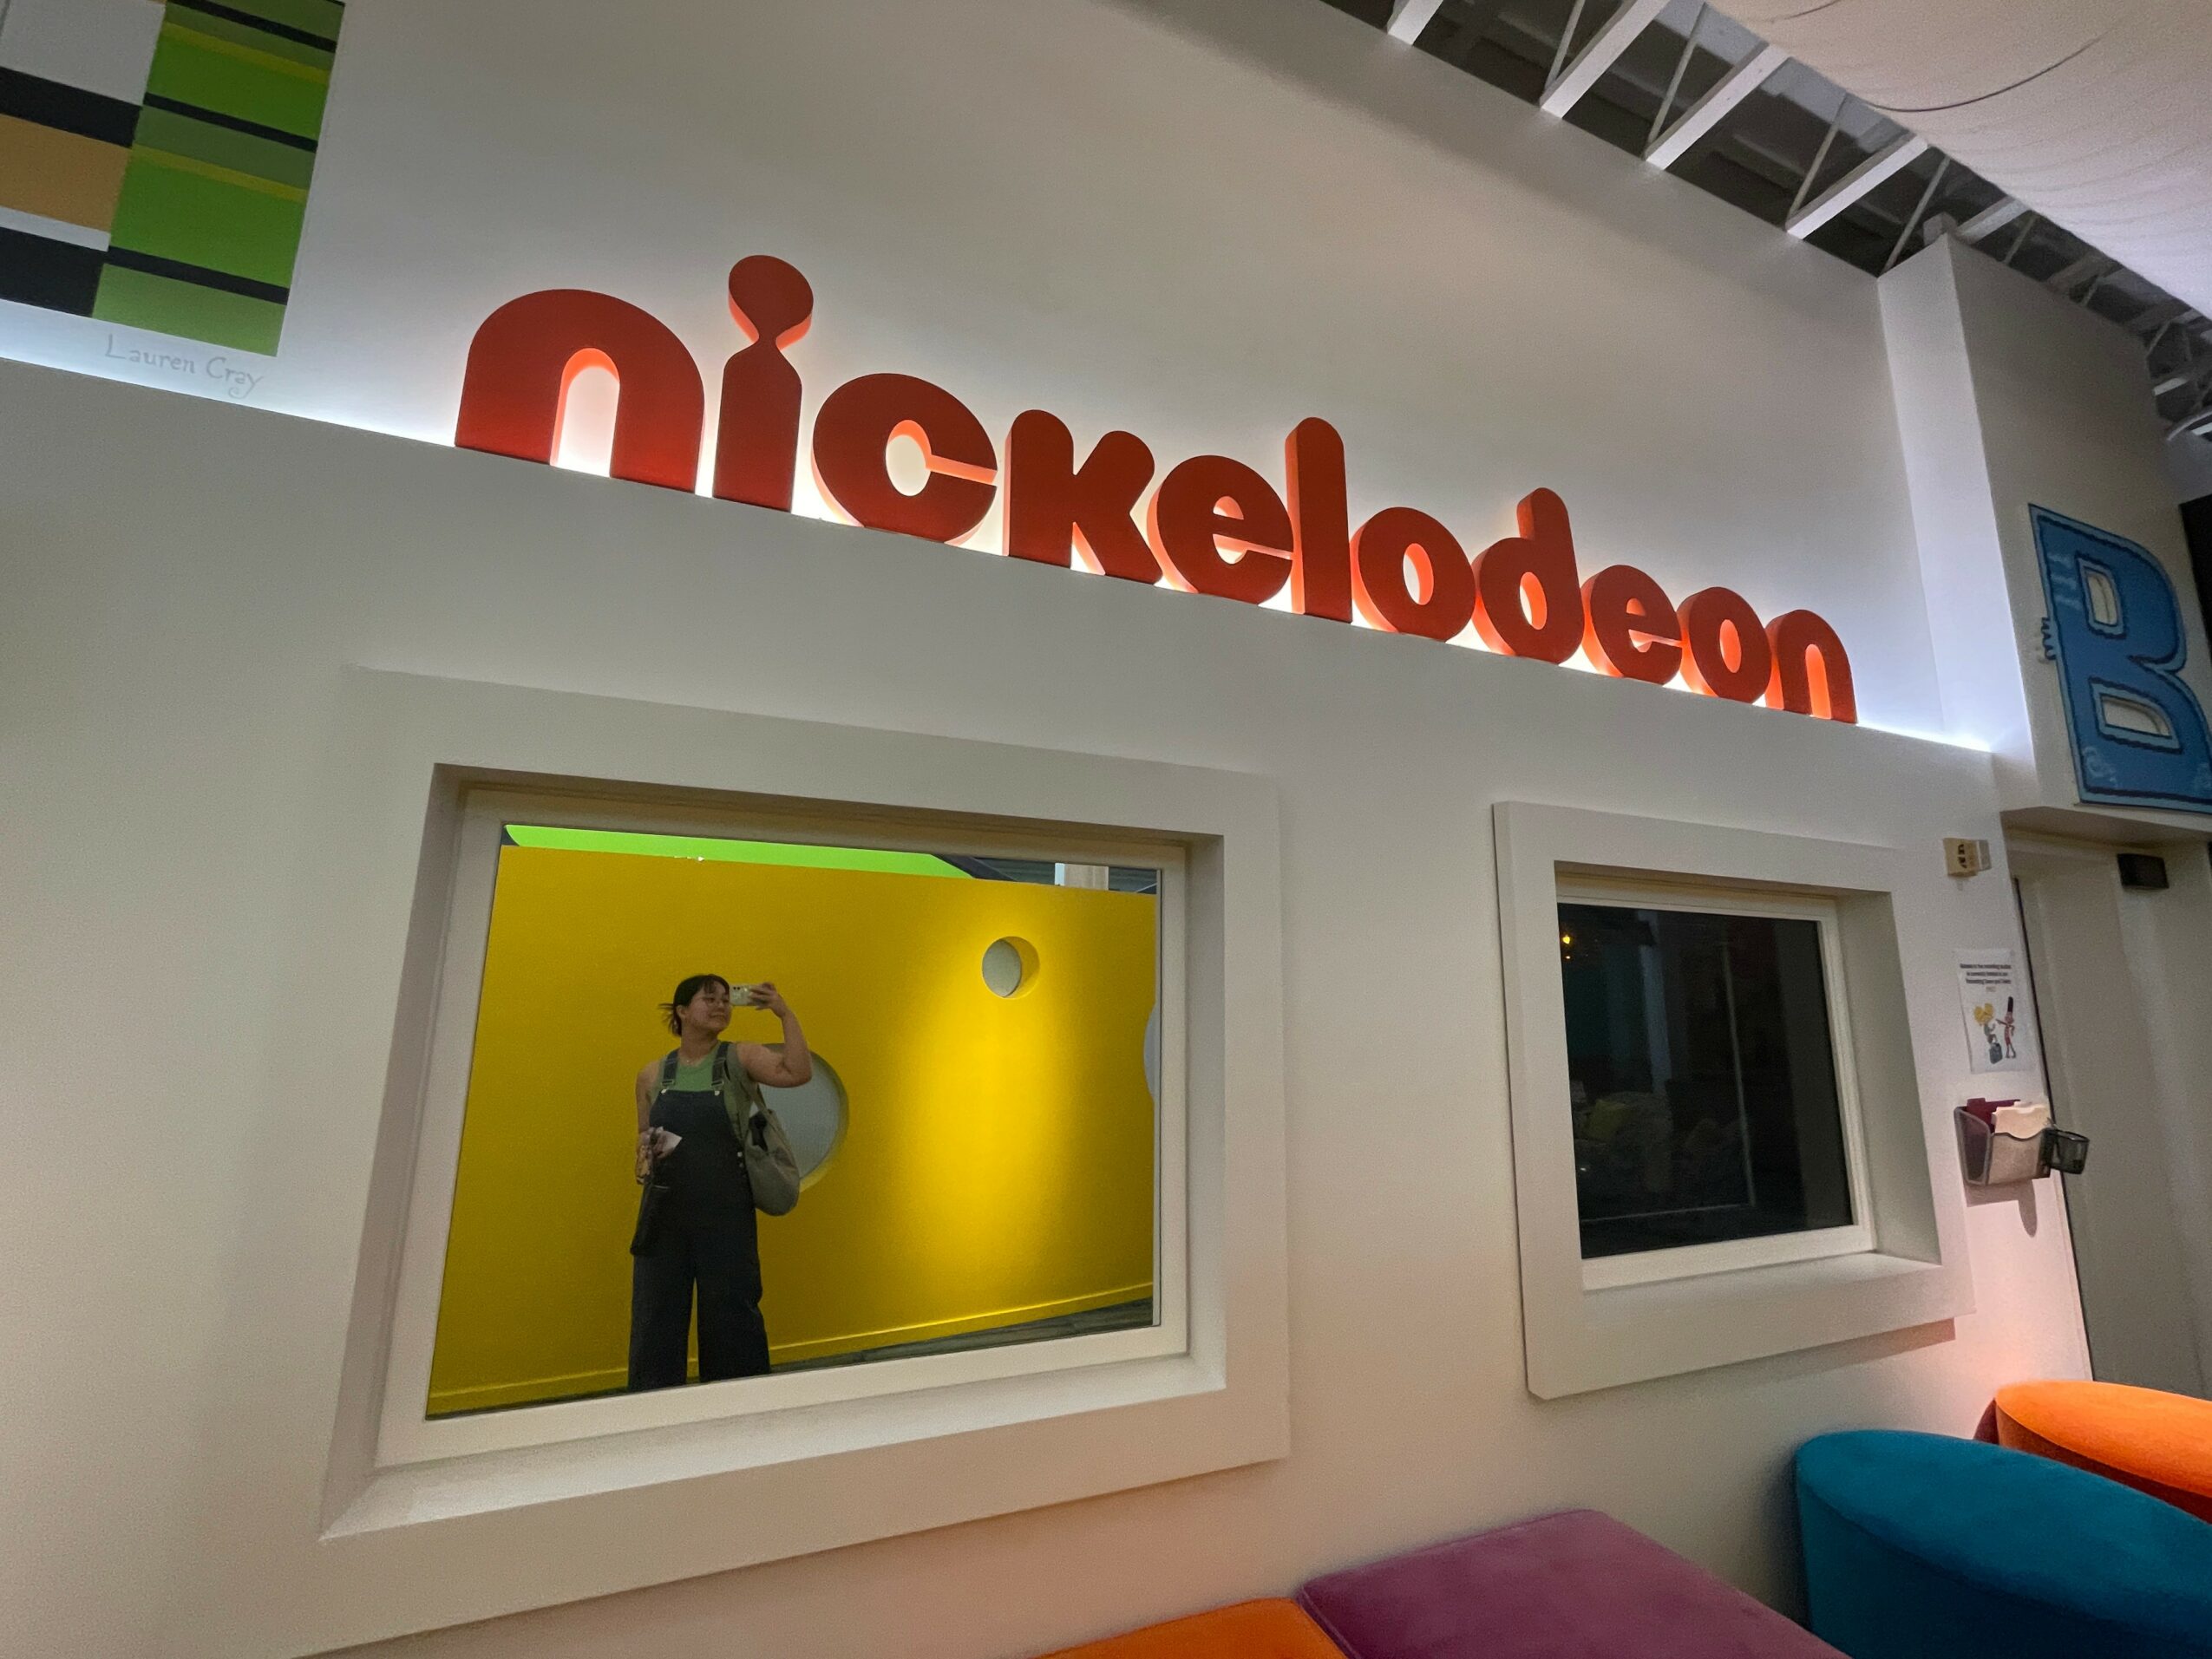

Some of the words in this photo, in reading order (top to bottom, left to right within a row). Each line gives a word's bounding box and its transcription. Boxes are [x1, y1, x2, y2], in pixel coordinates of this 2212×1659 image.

[104, 333, 196, 375] Lauren
[455, 255, 1858, 725] nickelodeon
[2029, 502, 2212, 814] B
